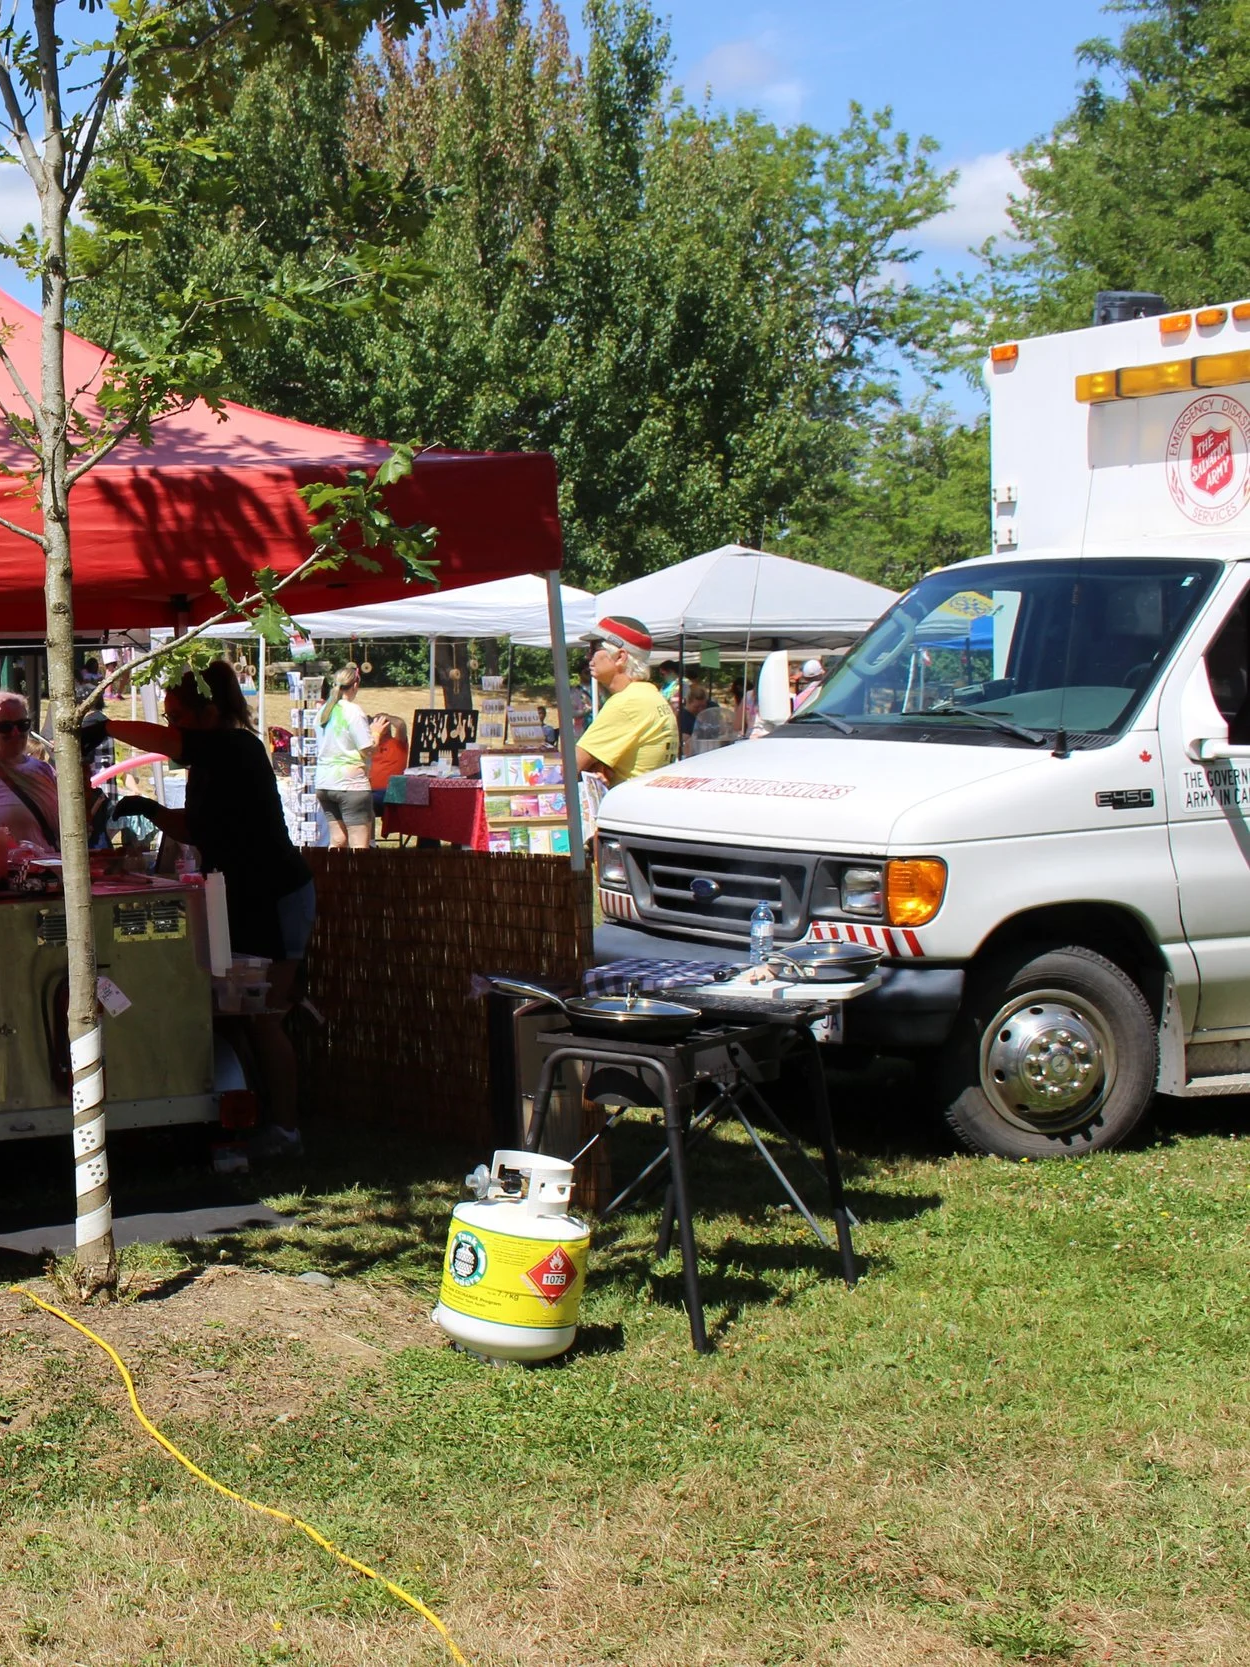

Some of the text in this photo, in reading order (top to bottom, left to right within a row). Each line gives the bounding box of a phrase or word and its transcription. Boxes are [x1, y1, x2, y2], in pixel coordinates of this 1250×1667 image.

[1170, 398, 1215, 456] EMERGENCY
[1196, 433, 1215, 457] THE
[1191, 435, 1230, 482] SALVATION
[1206, 456, 1230, 489] ARMY
[1192, 502, 1238, 521] SERVICES
[1184, 771, 1203, 789] THE
[765, 782, 857, 800] SERVICES
[1186, 787, 1250, 808] ARMY IN CA
[456, 1231, 478, 1247] Tank
[545, 1275, 565, 1284] 1075
